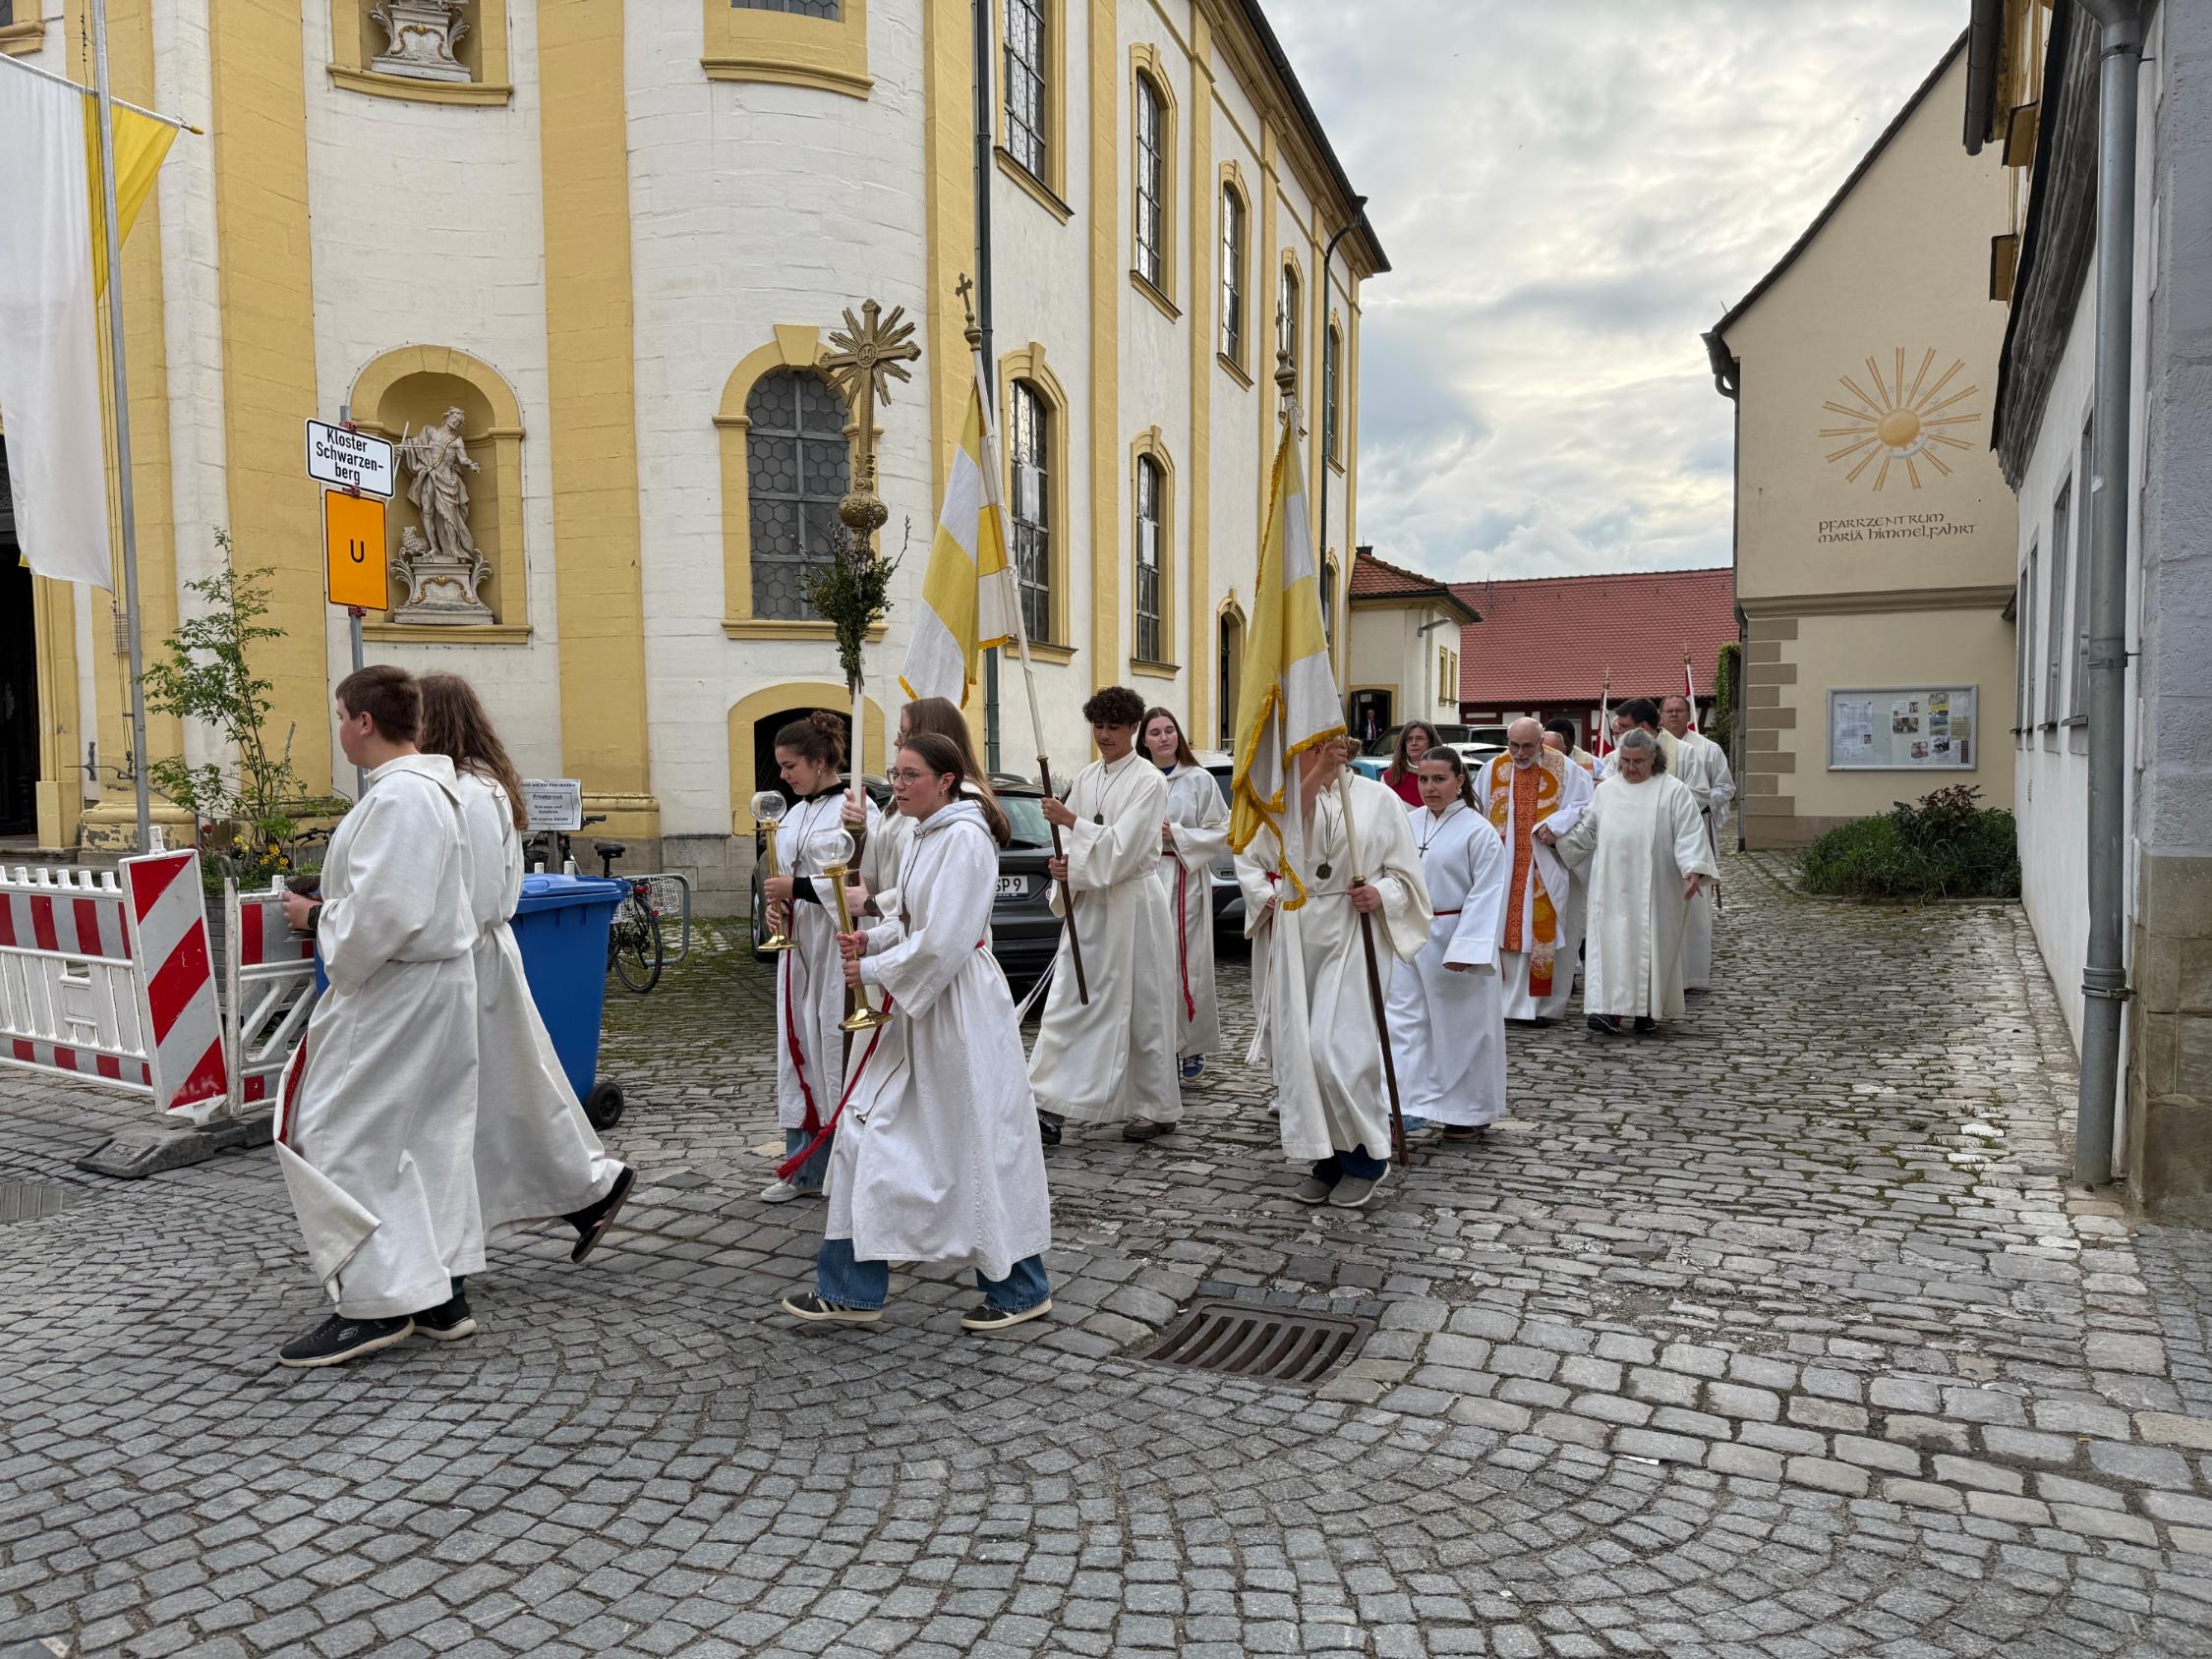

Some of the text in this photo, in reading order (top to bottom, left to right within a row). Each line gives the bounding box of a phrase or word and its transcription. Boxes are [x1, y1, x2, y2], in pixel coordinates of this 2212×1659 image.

[327, 428, 368, 452] Kloster
[316, 441, 384, 471] Schwarzen-
[334, 462, 360, 486] berg
[350, 539, 365, 563] U
[1013, 878, 1021, 892] 9
